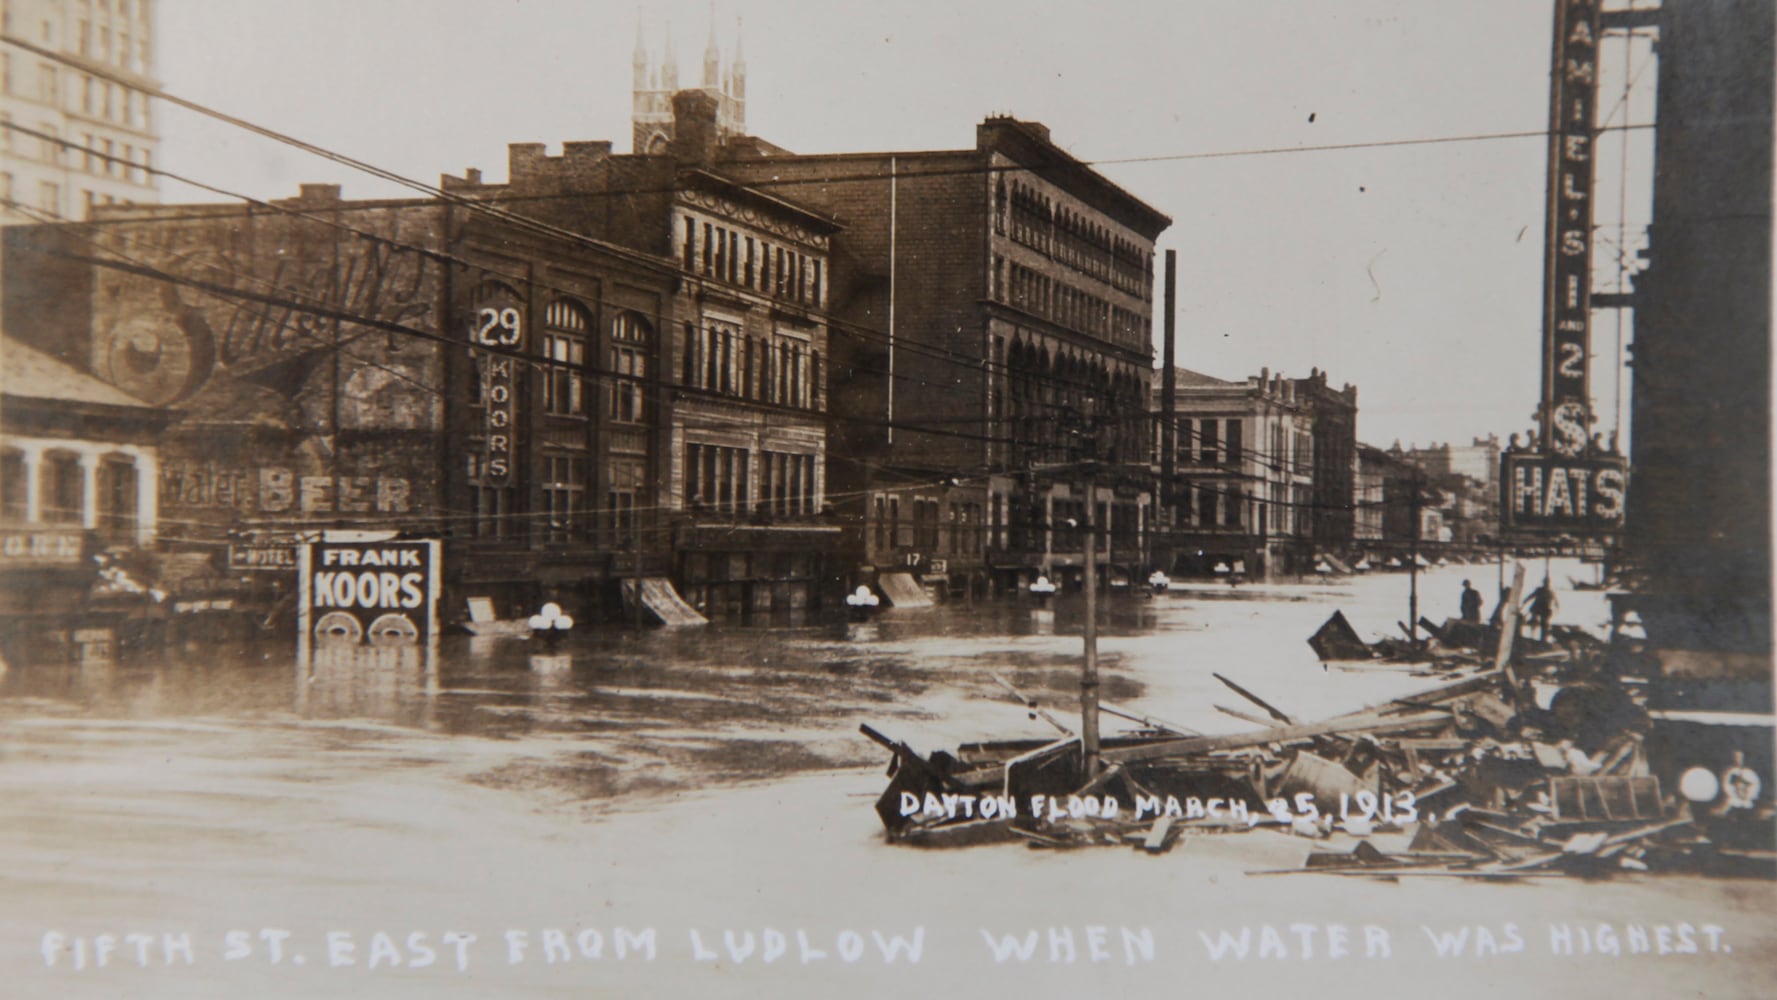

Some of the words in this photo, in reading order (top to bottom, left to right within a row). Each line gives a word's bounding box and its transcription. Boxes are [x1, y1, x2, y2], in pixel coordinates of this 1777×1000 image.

[1561, 0, 1594, 256] AMIEL'S
[479, 307, 522, 346] 29
[1558, 341, 1585, 379] 2
[490, 360, 509, 476] KOORS
[260, 466, 411, 513] BEER
[1514, 465, 1627, 520] HATS
[323, 549, 422, 567] FRANK
[906, 552, 921, 567] 17
[314, 570, 424, 609] KOORS
